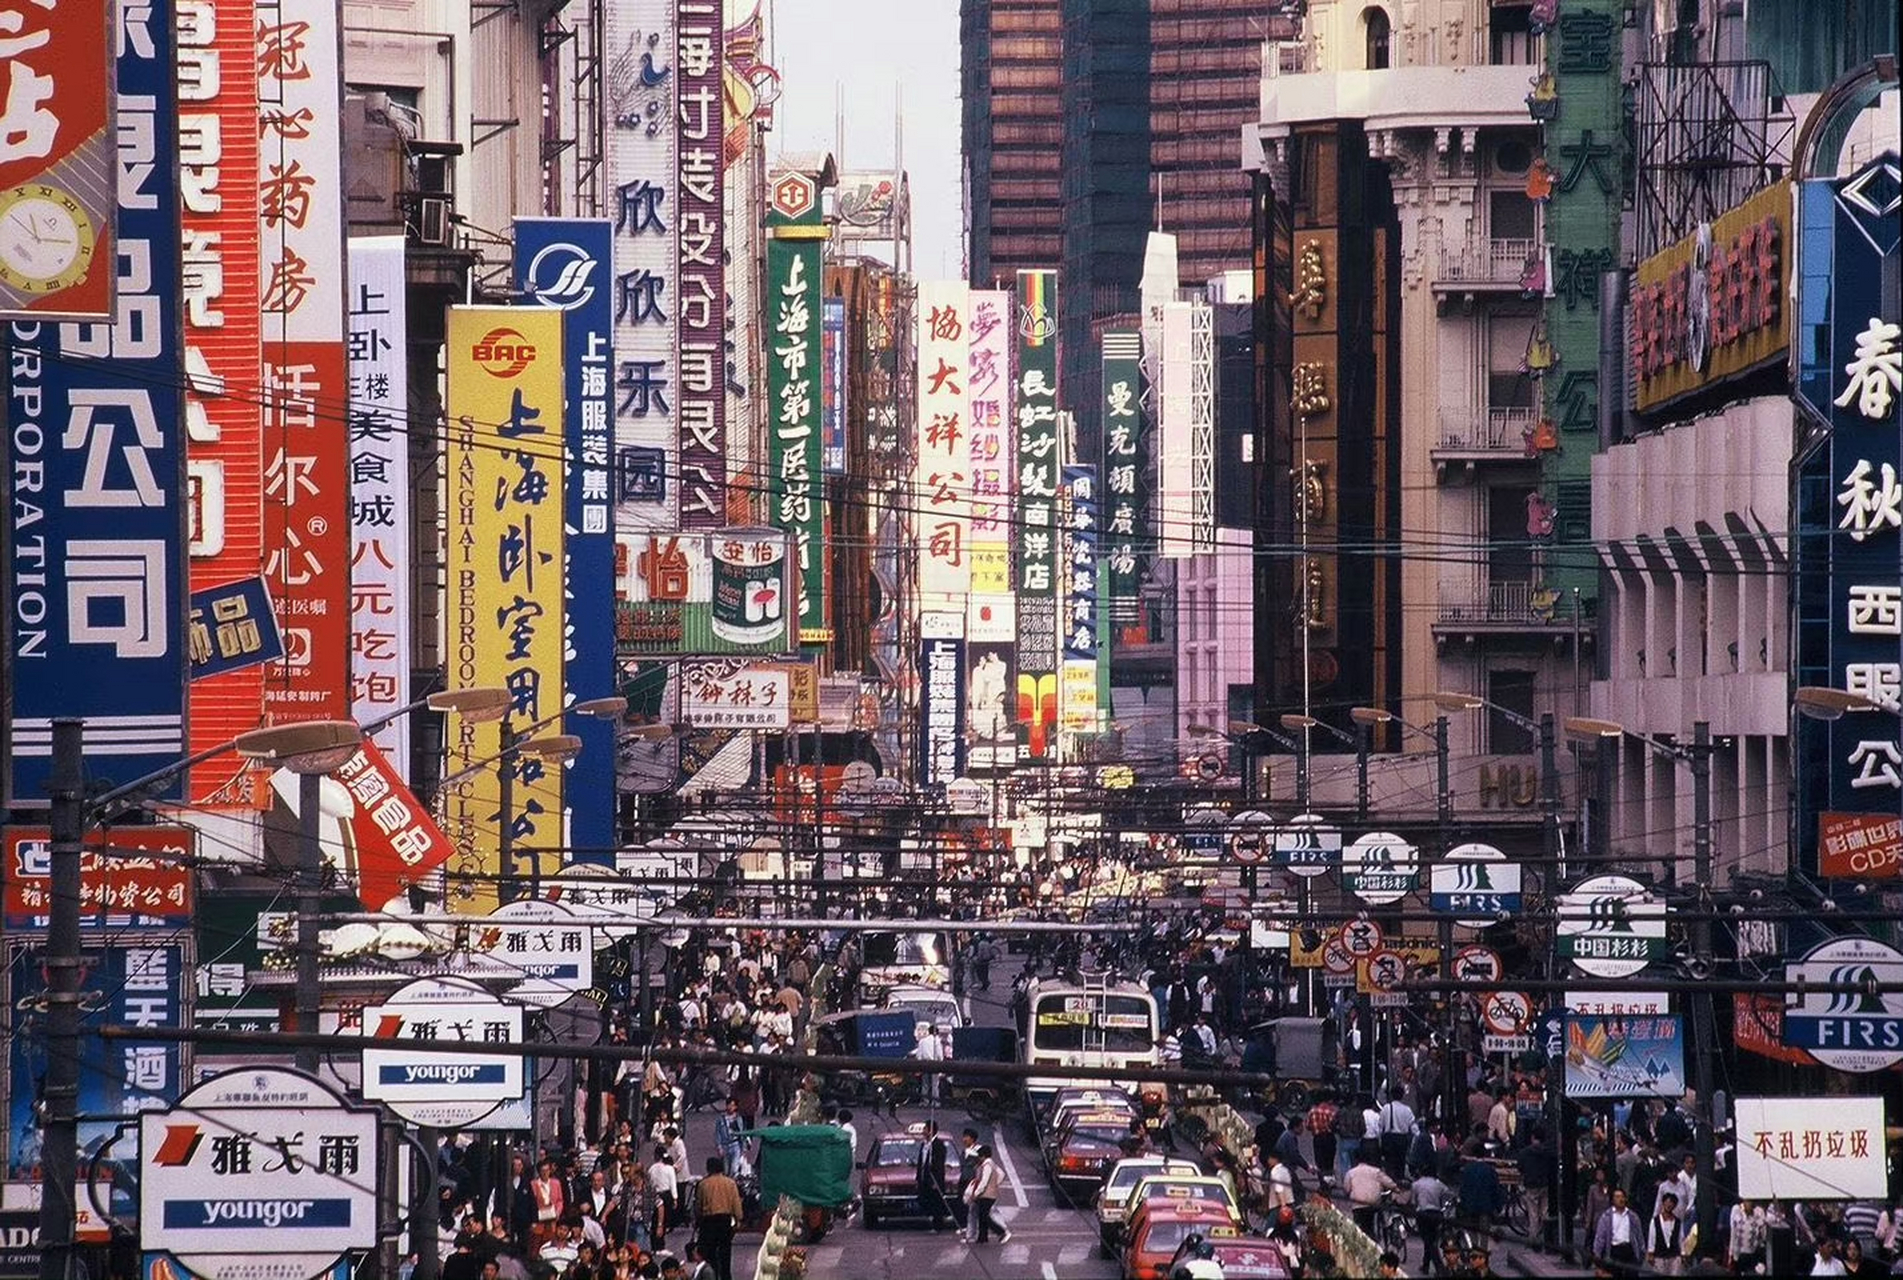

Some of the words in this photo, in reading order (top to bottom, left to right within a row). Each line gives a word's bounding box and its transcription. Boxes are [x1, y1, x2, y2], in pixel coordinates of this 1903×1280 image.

[472, 344, 536, 363] BAC
[615, 178, 671, 503] 欣欣乐园
[458, 415, 476, 563] SHANGHAI
[458, 570, 476, 691] BEDROO
[1354, 876, 1409, 889] 中国杉杉
[1573, 937, 1649, 958] 中国杉杉
[405, 1065, 481, 1085] youngor
[1753, 1129, 1870, 1161] 不乱扔垃圾
[202, 1200, 314, 1228] youngor
